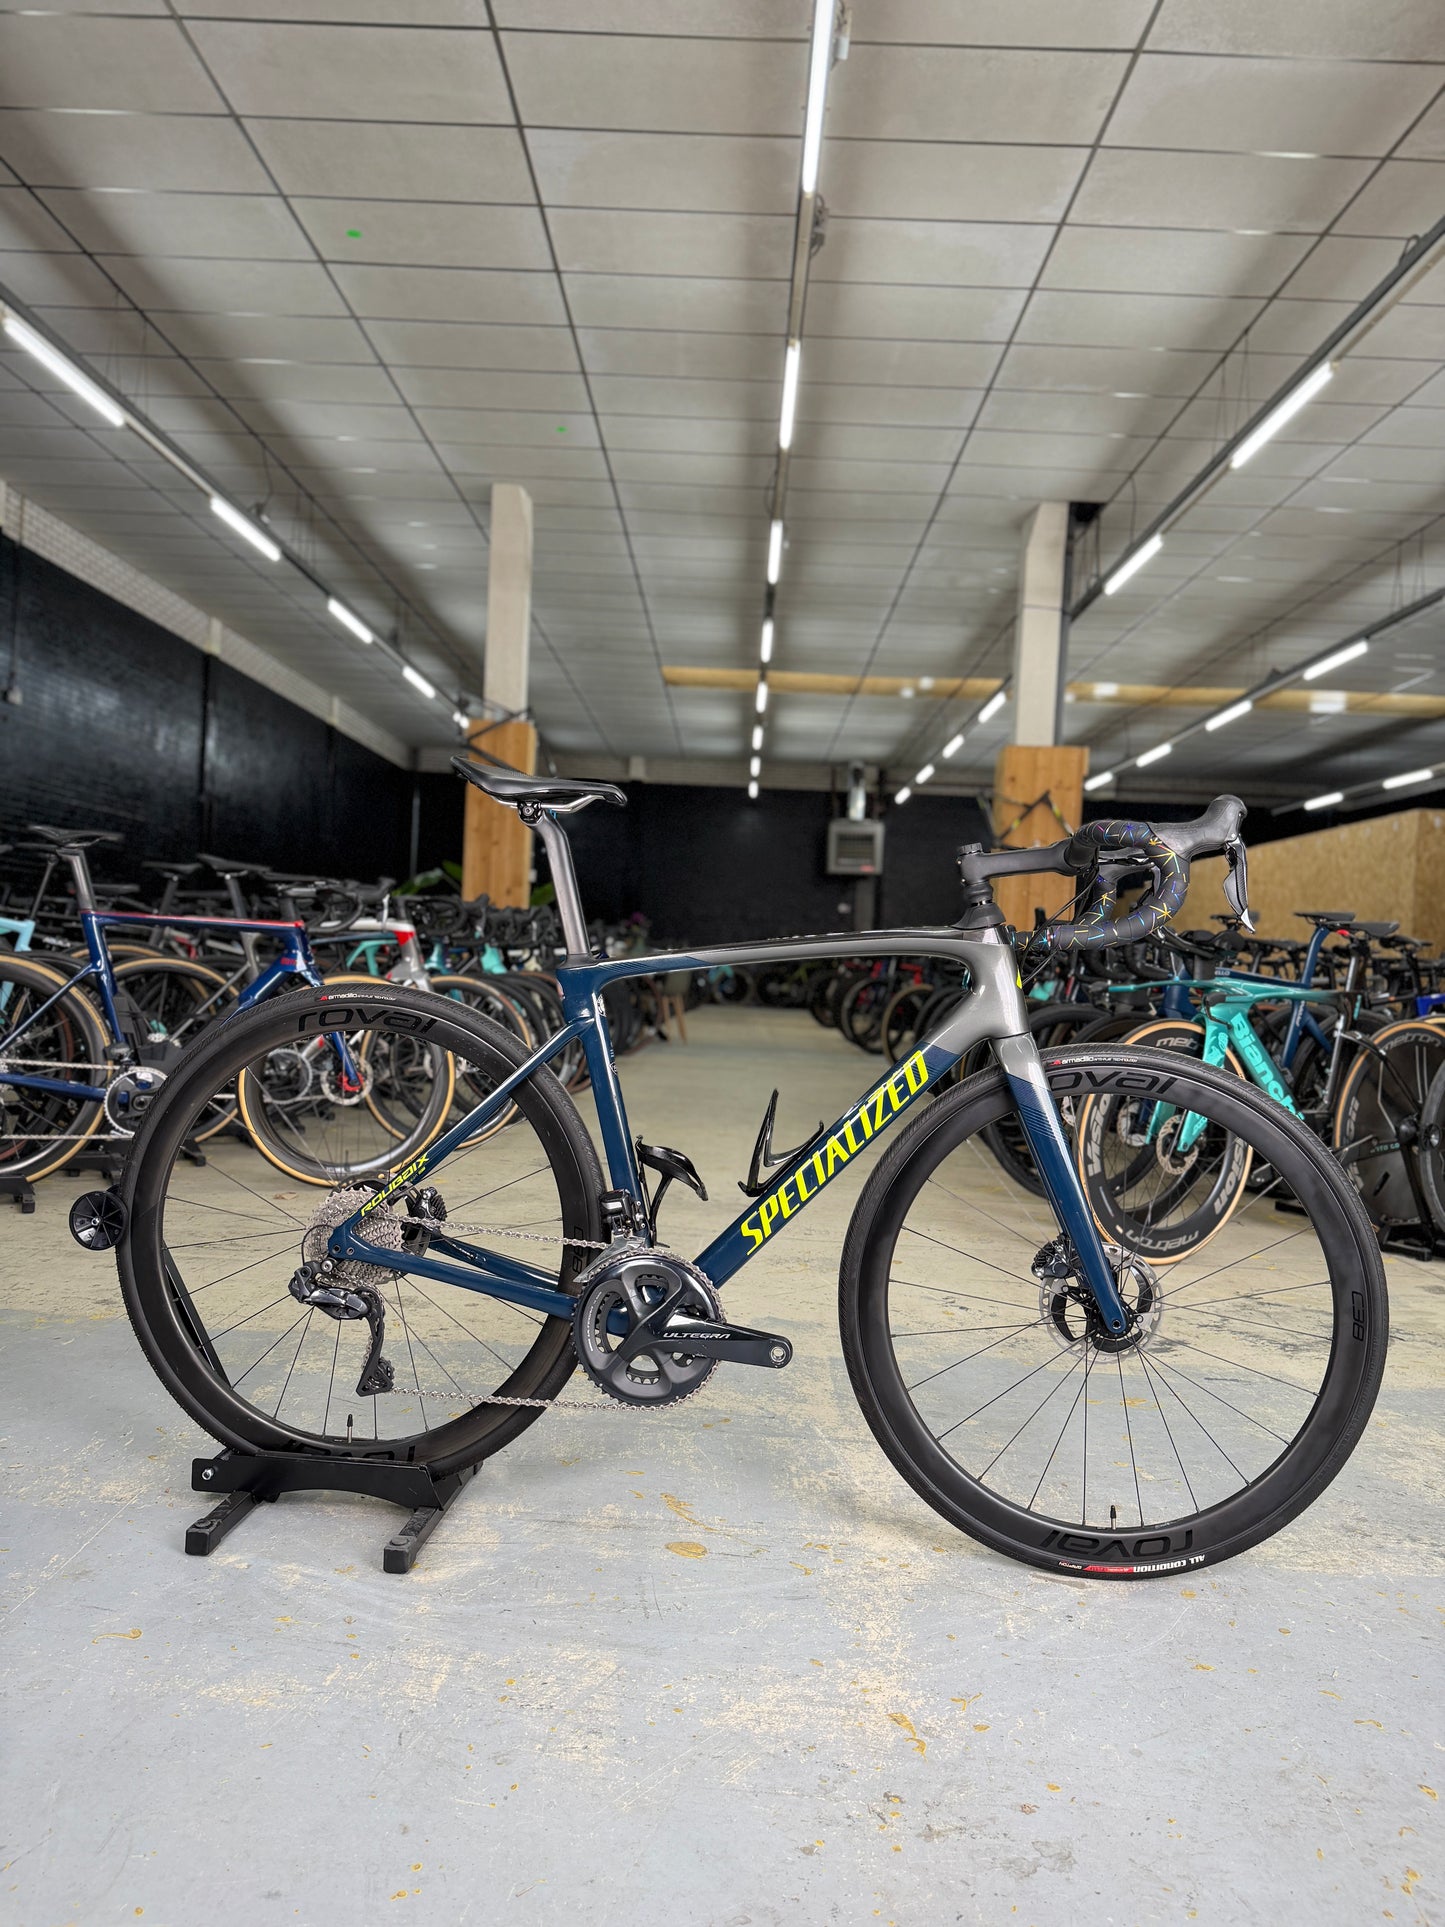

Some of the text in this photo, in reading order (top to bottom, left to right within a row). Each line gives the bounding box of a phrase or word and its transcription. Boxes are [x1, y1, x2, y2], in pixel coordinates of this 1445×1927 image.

[299, 1008, 438, 1033] roval
[1047, 1070, 1178, 1095] oval
[1087, 1094, 1112, 1177] Visio
[740, 1050, 929, 1256] SPECIALIZED
[1125, 1230, 1200, 1251] metron
[663, 1332, 731, 1340] ULTEGRA
[1039, 1529, 1194, 1558] roval
[1133, 1560, 1188, 1573] CONDITION
[1188, 1554, 1206, 1564] ALL
